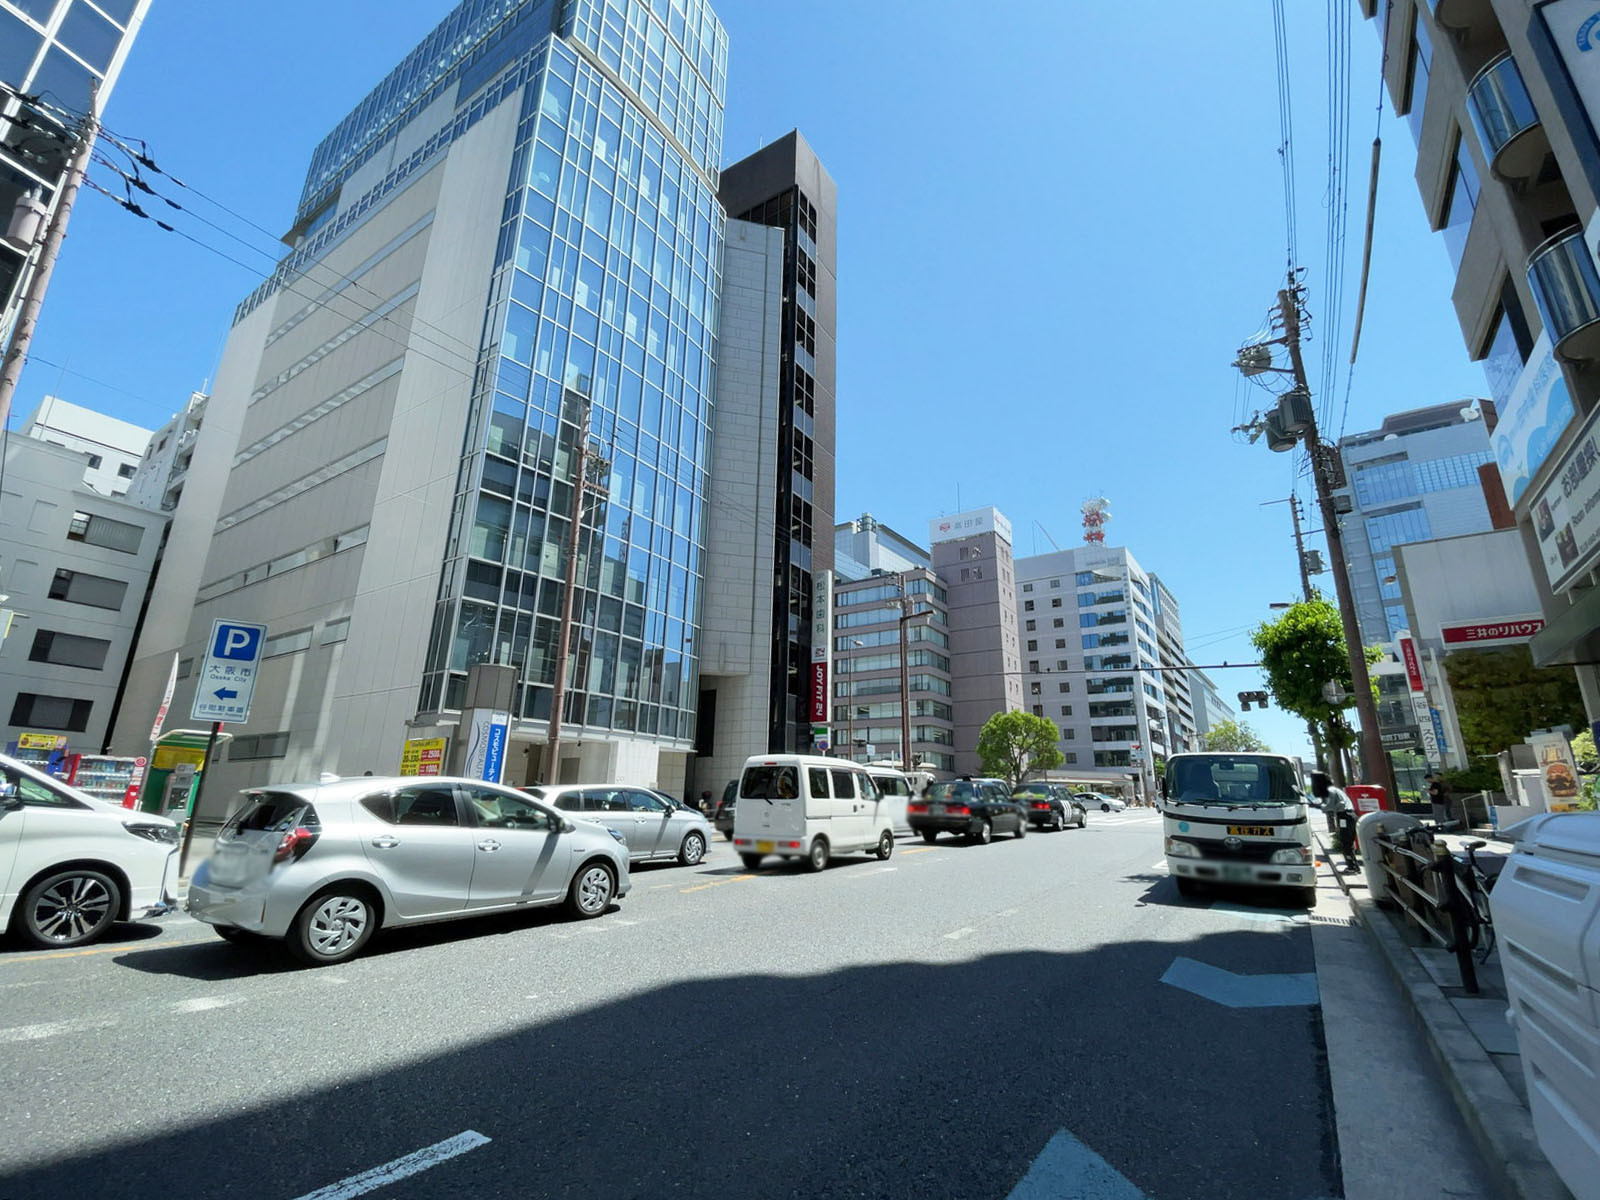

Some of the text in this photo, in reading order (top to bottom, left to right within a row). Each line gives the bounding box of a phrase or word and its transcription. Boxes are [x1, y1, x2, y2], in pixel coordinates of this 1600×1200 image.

[1466, 623, 1542, 639] 三井のリハウス
[224, 629, 250, 656] P
[209, 665, 251, 676] 大阪市
[1416, 701, 1438, 758] 谷四スクエア
